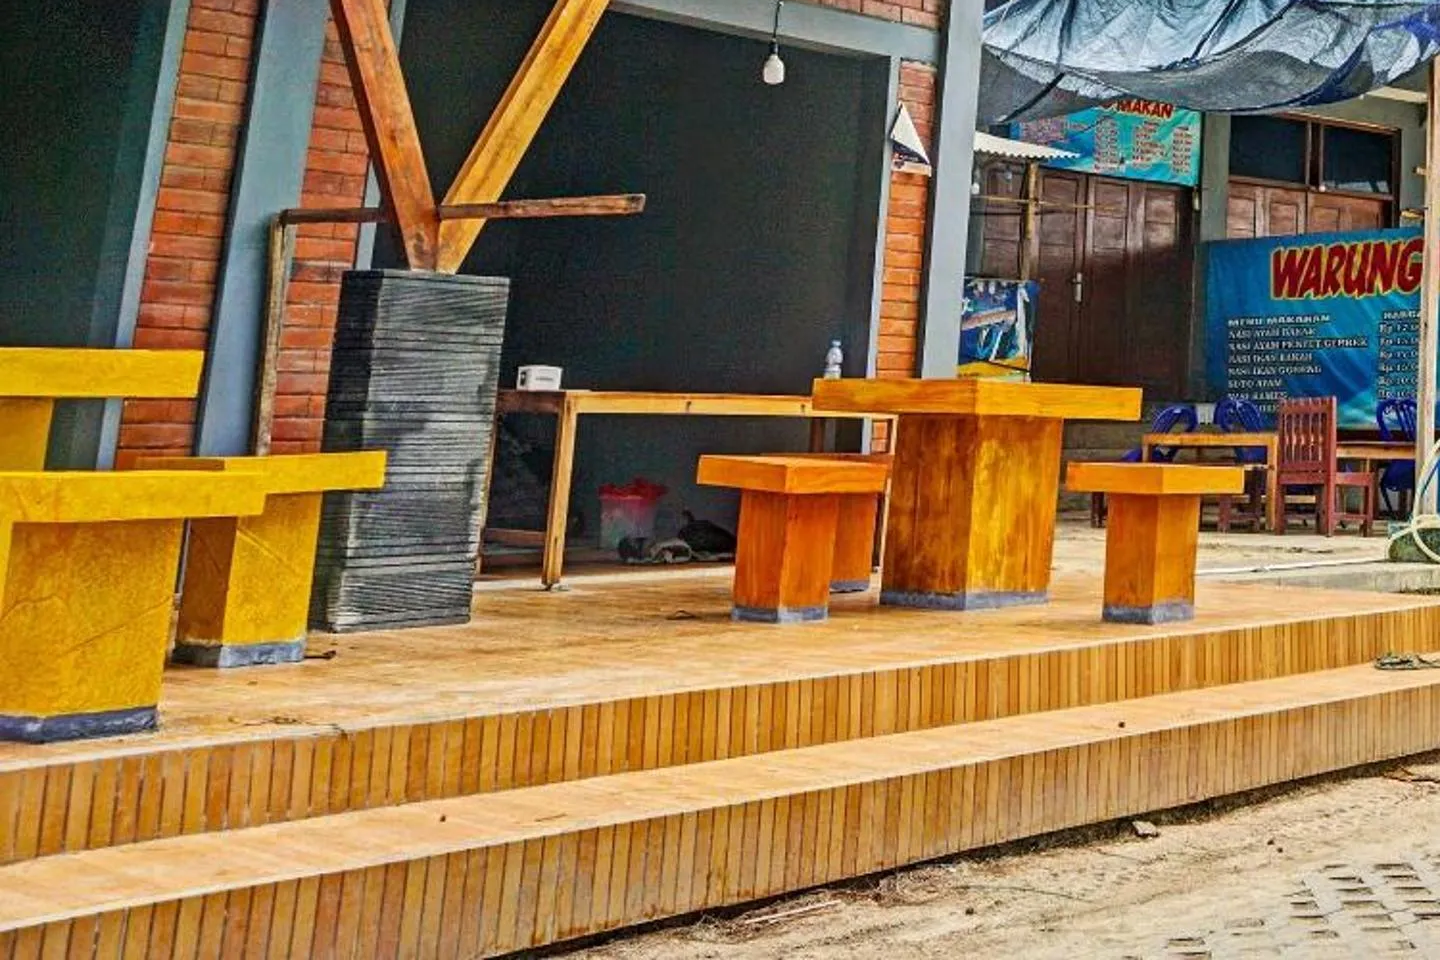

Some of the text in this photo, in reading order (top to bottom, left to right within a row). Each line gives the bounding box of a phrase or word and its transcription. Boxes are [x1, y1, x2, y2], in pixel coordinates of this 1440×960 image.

[1271, 236, 1424, 299] WARUNG
[1228, 314, 1331, 327] MENU MAKANAN
